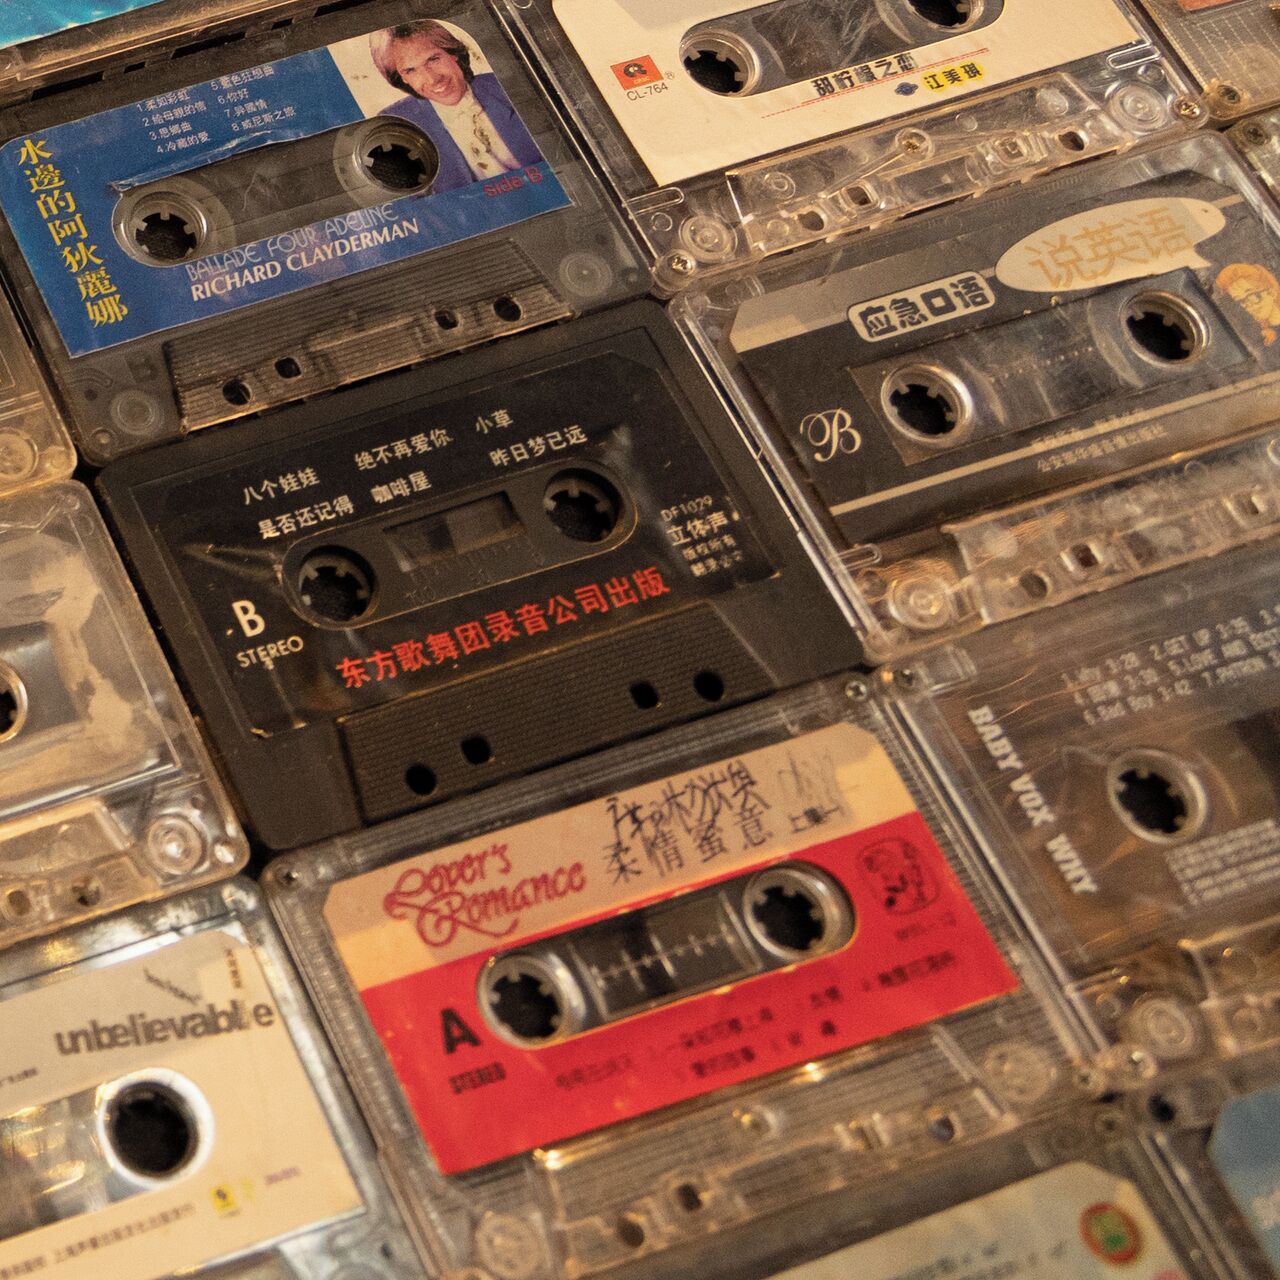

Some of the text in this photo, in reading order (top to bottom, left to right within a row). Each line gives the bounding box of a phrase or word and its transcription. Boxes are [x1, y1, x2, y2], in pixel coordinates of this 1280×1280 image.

[216, 87, 251, 106] 6.你好
[624, 80, 670, 102] CL-764
[922, 61, 983, 91] 江美琪
[480, 166, 544, 197] side B
[14, 135, 130, 330] 水邊的阿狄麗娜
[183, 201, 400, 282] BALLADE FOUR ADELINE
[188, 216, 423, 302] RICHARD CLAYDERMAN
[1024, 206, 1193, 288] 说英语
[864, 276, 990, 339] 应急口语
[237, 408, 516, 505] 八个娃娃 绝不再爱你 小草
[799, 407, 863, 462] B
[253, 424, 590, 541] 是否还记得 咖啡屋 昨日梦已远
[663, 510, 733, 546] 立体声
[231, 597, 268, 638] B
[331, 562, 672, 693] 东方歌舞团录音公司出版
[234, 633, 306, 669] STEREO
[968, 704, 1100, 895] BABY VOX WHY
[441, 1008, 483, 1055] A
